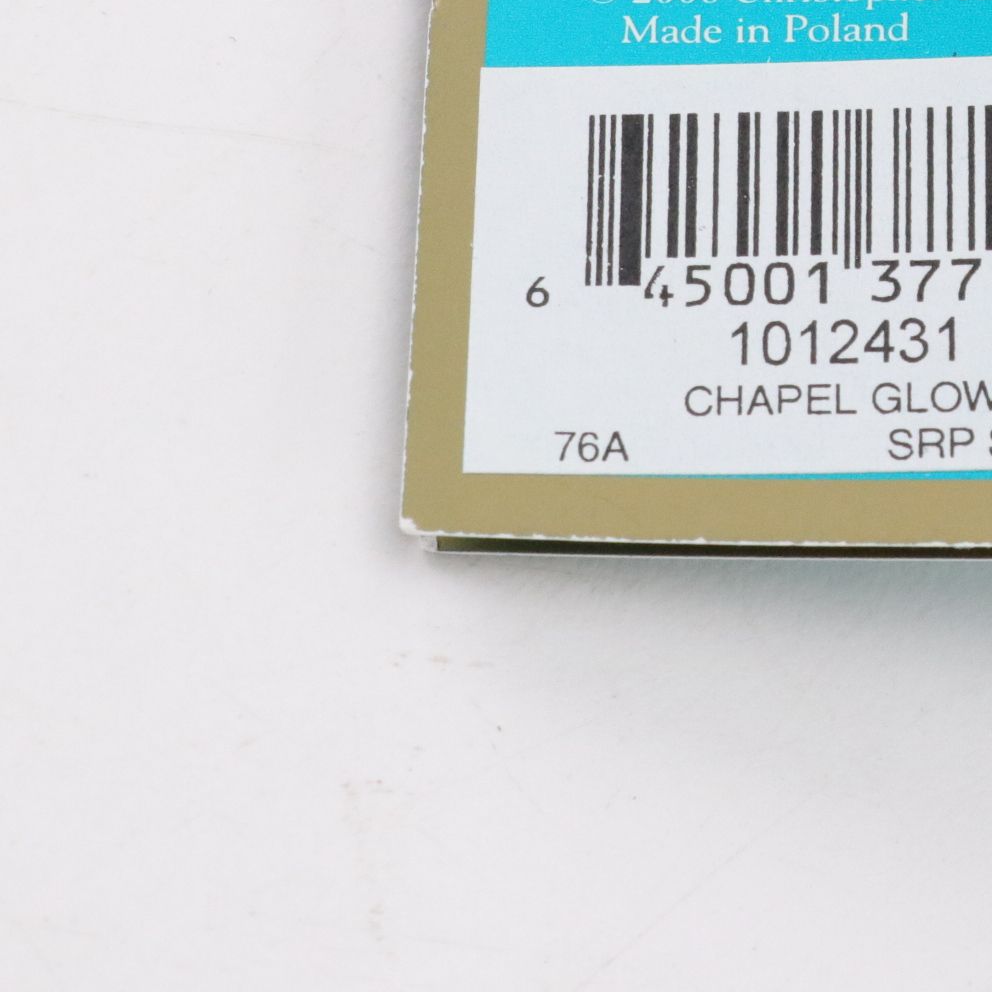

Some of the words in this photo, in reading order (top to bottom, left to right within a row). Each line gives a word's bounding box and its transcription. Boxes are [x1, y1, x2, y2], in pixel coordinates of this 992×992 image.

[621, 14, 722, 44] Made
[736, 17, 770, 44] in
[784, 11, 909, 43] Poland
[526, 276, 550, 308] 6
[644, 261, 828, 308] 45001
[731, 316, 956, 366] 1012431
[684, 383, 857, 417] CHAPEL
[555, 431, 629, 463] 76A
[888, 427, 975, 461] SRP
